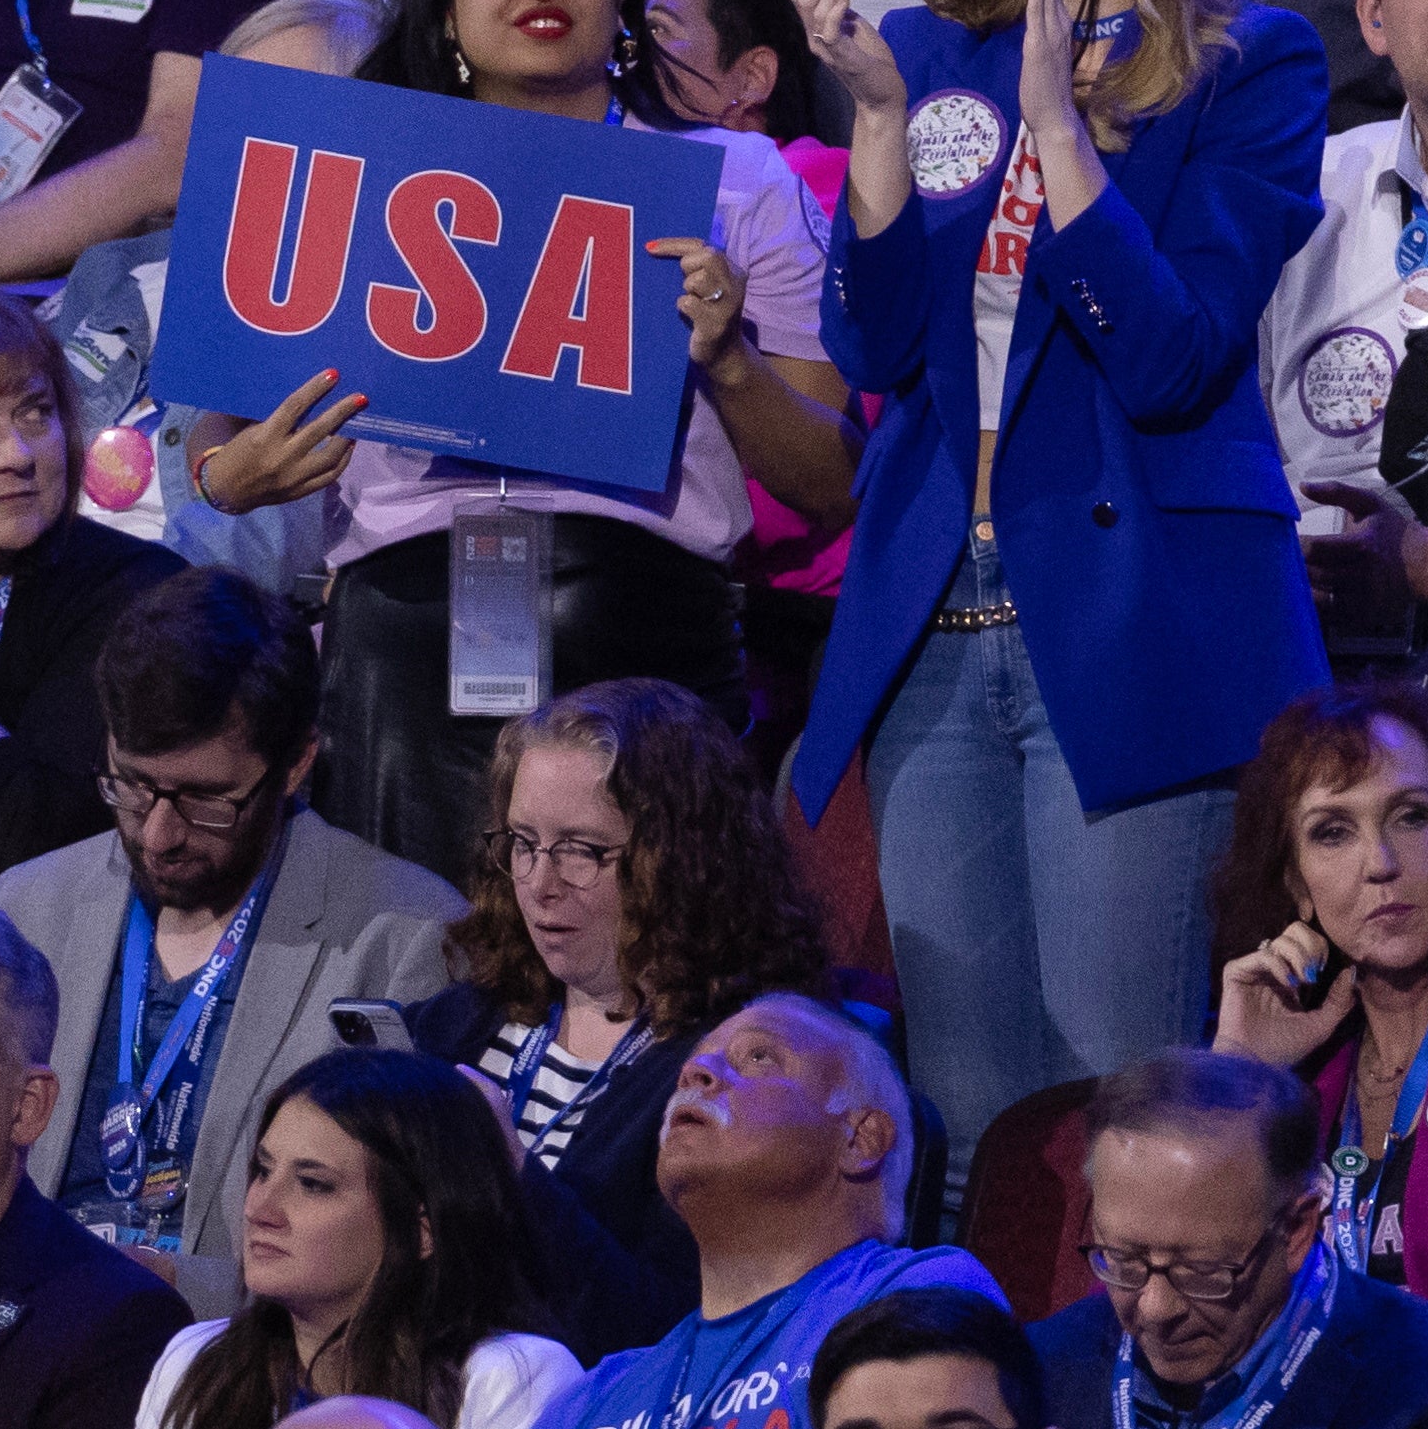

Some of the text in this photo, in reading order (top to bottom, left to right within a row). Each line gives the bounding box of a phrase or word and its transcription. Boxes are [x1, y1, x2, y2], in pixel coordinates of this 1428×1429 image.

[222, 136, 634, 395] USA
[194, 954, 227, 998] DNC
[188, 995, 218, 1066] Nationwide
[166, 1082, 193, 1150] Nationwide
[1339, 1176, 1356, 1210] DNC
